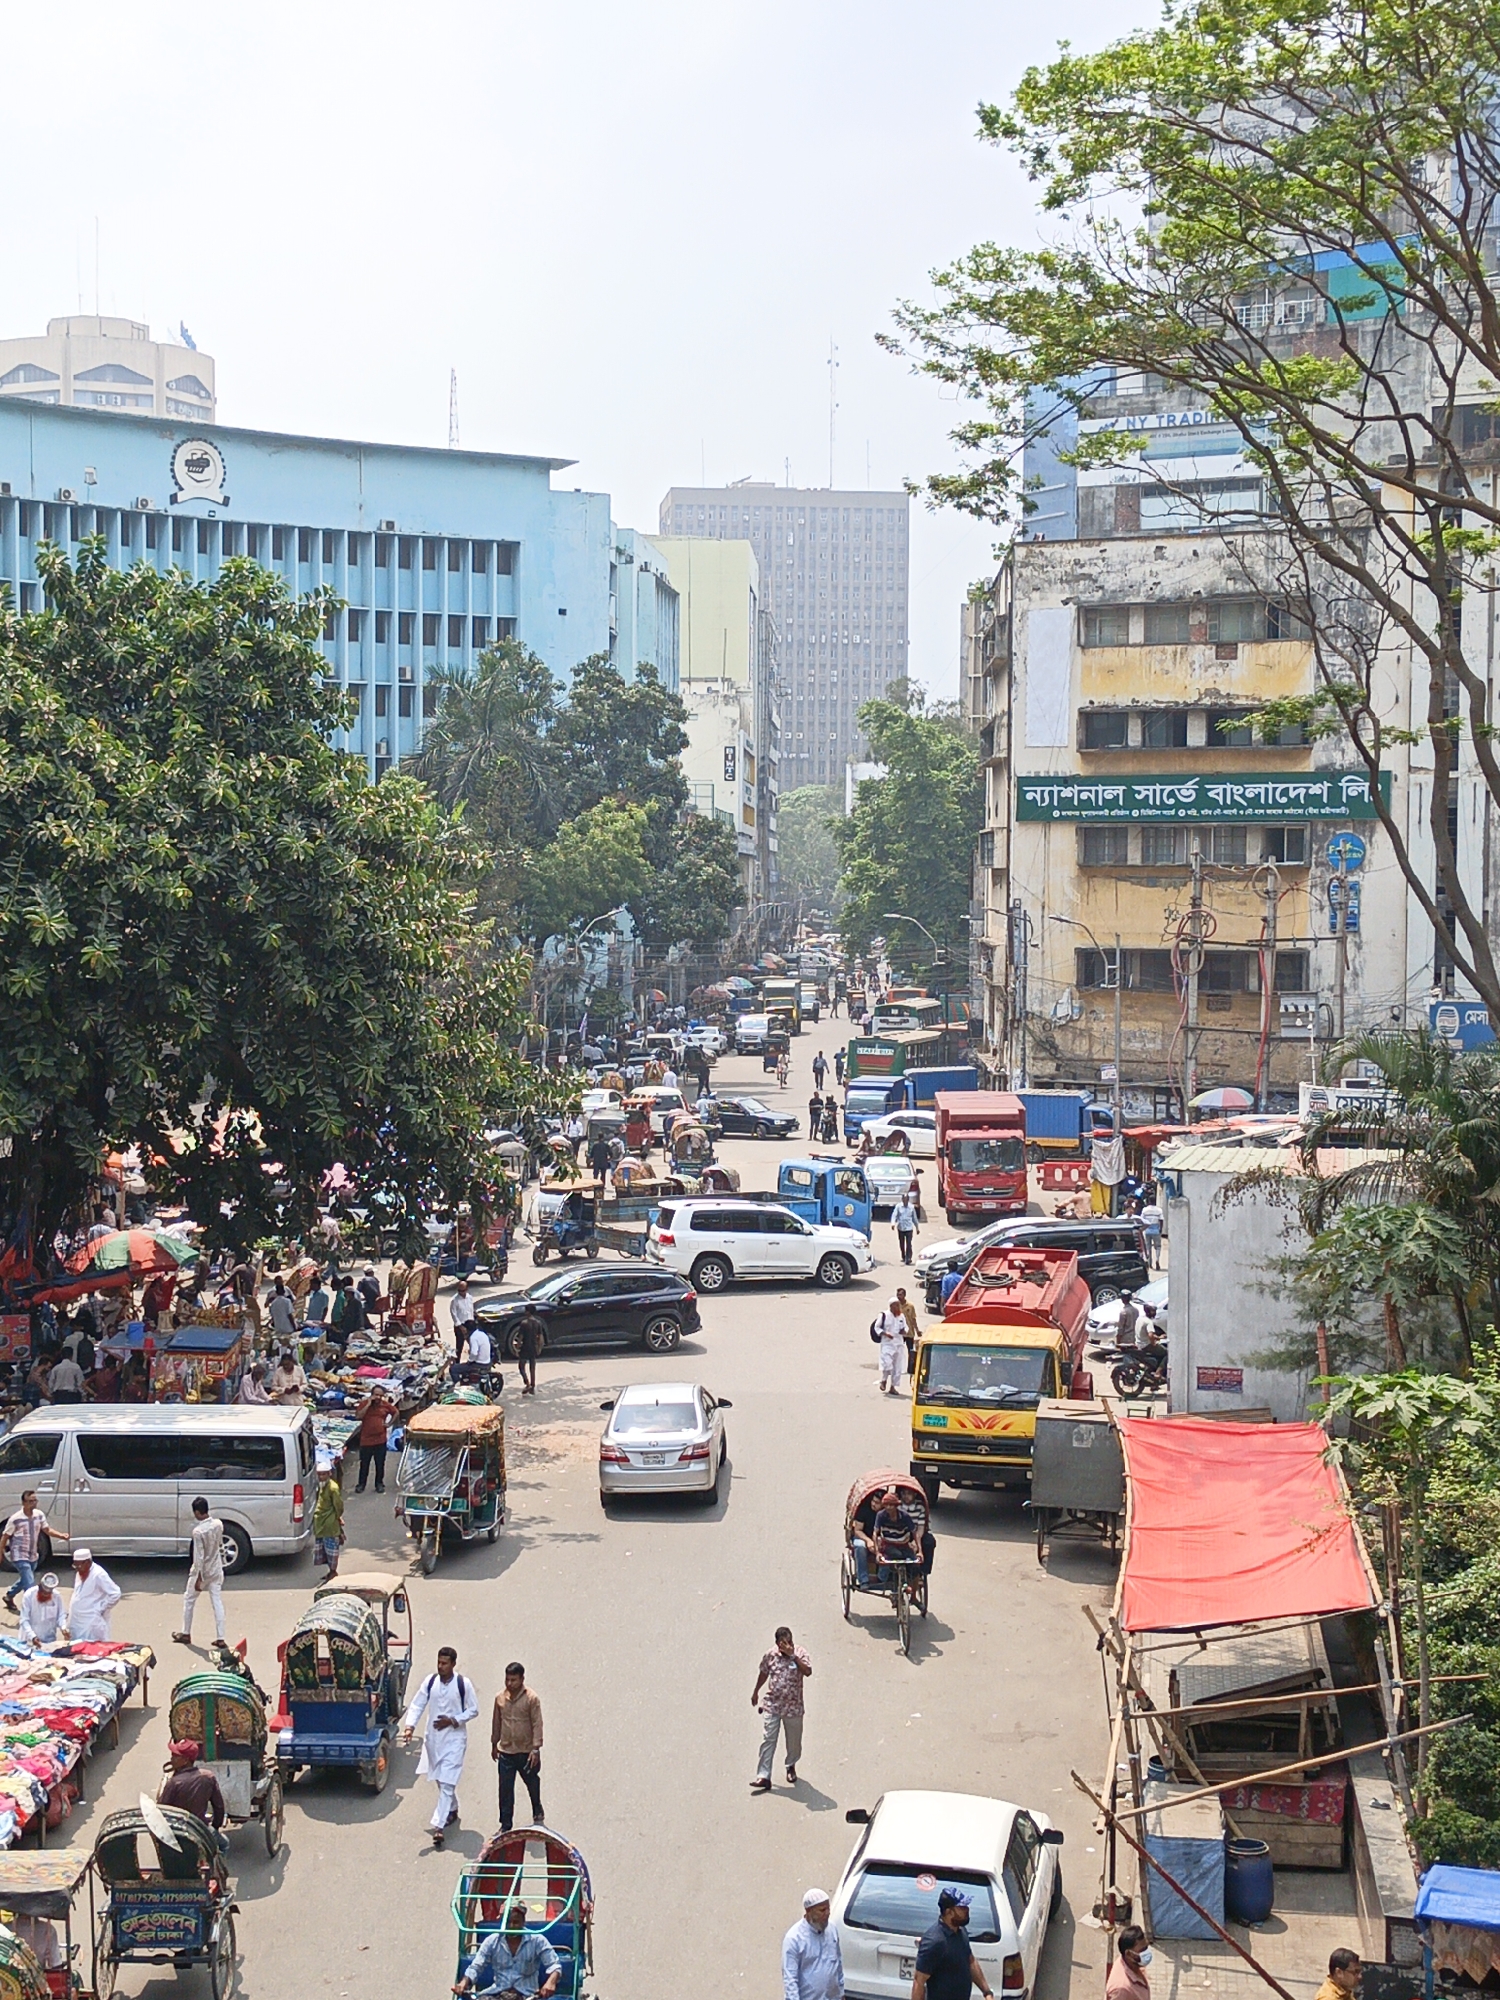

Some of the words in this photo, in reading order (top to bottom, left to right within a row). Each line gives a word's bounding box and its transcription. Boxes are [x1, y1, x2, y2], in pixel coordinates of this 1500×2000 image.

[1127, 417, 1147, 430] NY
[725, 747, 735, 780] BIWTC
[1022, 784, 1127, 807] ন্যাশনাল
[1132, 777, 1200, 806] সার্ভে
[1204, 780, 1333, 807] বাংলাদেশ
[1465, 1010, 1489, 1026] মেসা
